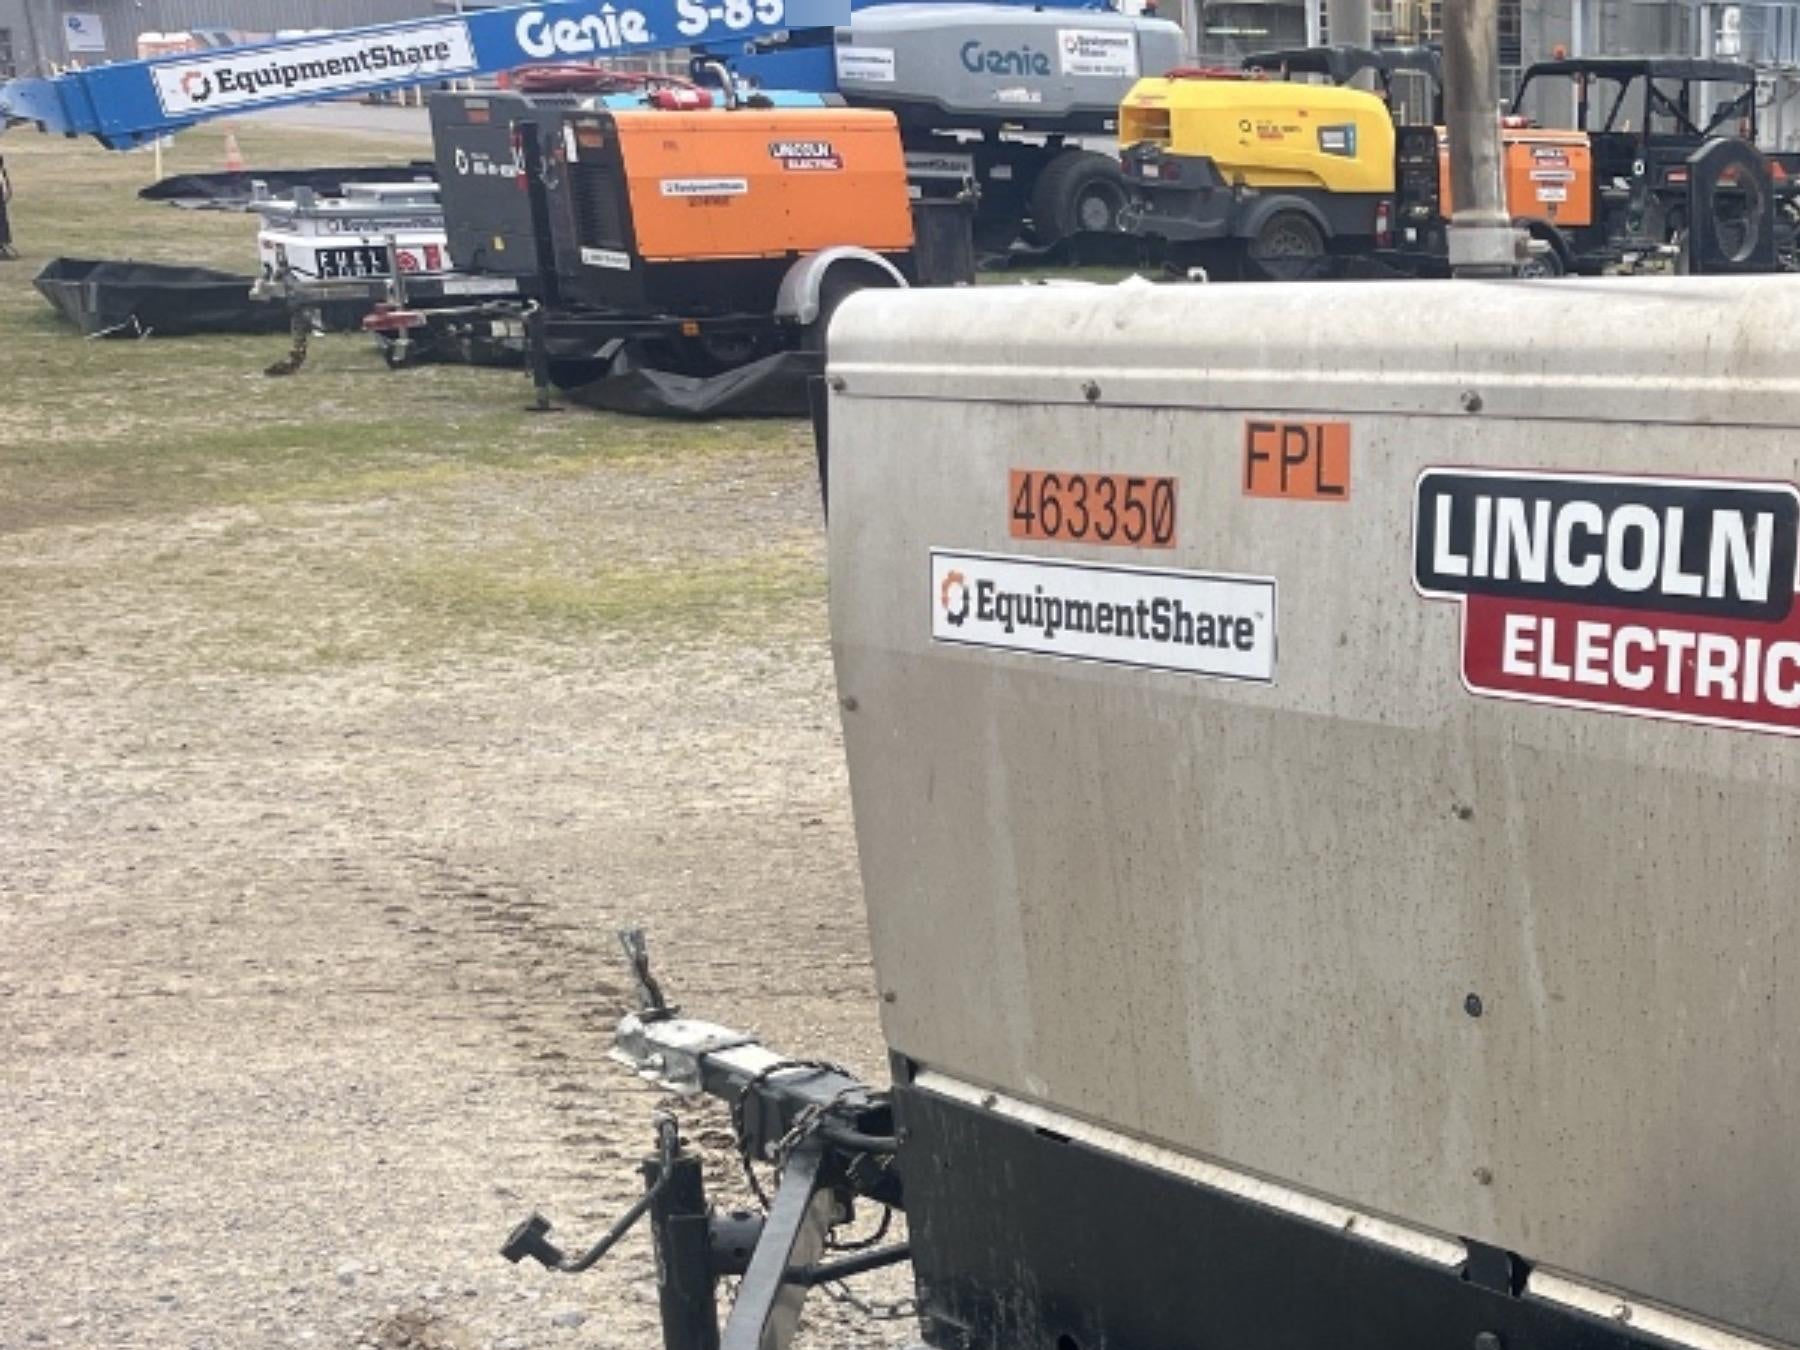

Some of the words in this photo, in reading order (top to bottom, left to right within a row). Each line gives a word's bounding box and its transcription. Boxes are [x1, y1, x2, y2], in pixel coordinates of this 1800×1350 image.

[214, 41, 450, 93] EquipmentShare
[516, 4, 650, 58] Genie
[960, 40, 1051, 75] Genie
[1247, 423, 1345, 495] FPL
[1011, 473, 1176, 545] 463350
[1433, 494, 1774, 602] LINCOLN
[976, 579, 1256, 653] EquipmentShare
